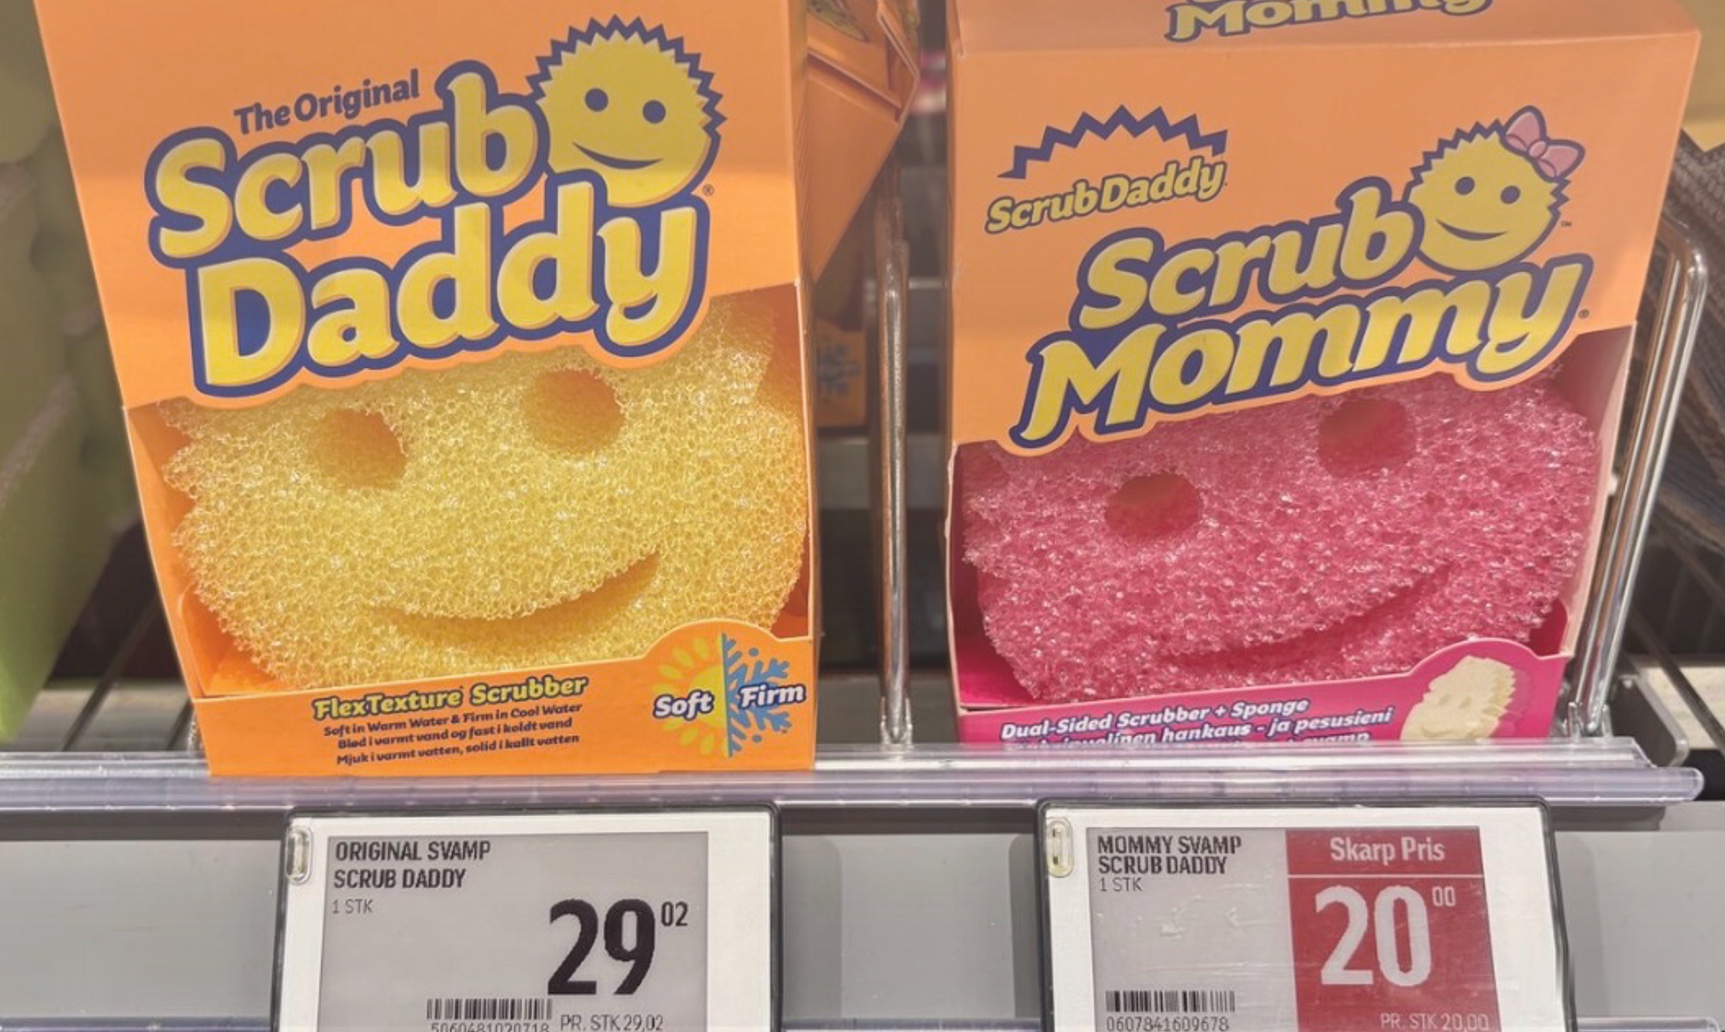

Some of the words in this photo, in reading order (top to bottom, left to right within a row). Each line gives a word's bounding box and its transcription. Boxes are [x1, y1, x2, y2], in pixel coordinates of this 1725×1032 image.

[234, 102, 291, 135] The
[295, 69, 420, 123] Original
[147, 61, 546, 266] Scrub
[985, 178, 1099, 234] Scrub
[1099, 155, 1227, 212] Daddy
[1070, 177, 1425, 333] Scrub
[187, 171, 708, 397] Daddy
[1010, 254, 1592, 447] Mommy
[312, 690, 463, 720] FlexTexture
[470, 675, 589, 706] Scrubber
[653, 689, 715, 721] Soft
[738, 682, 807, 709] Firm
[324, 724, 350, 738] Soft
[352, 725, 365, 734] in
[367, 721, 407, 732] Warm
[409, 717, 449, 728] Water
[451, 714, 461, 724] &
[463, 711, 493, 723] Firm
[496, 709, 508, 720] in
[510, 706, 540, 718] Cool
[542, 703, 583, 715] Water
[375, 733, 415, 745] varmt
[417, 729, 449, 741] vand
[451, 730, 467, 741] og
[469, 726, 495, 740] fast
[503, 721, 538, 734] koldt
[540, 717, 573, 730] vand
[1000, 712, 1113, 740] Dual-Sided
[1116, 705, 1211, 728] Scrubber
[1230, 699, 1310, 720] Sponge
[1161, 722, 1251, 742] hankaus
[1267, 717, 1292, 737] ja
[1294, 706, 1395, 733] pesusieni
[336, 753, 369, 767] Mjuk
[376, 749, 416, 761] varmt
[466, 740, 497, 753] solid
[505, 737, 535, 750] kallt
[537, 734, 580, 746] vatten
[335, 841, 422, 861] ORIGINAL
[427, 840, 491, 860] SVAMP
[1098, 835, 1172, 854] MOMMY
[1177, 835, 1242, 854] SVAMP
[1330, 837, 1395, 863] Skarp
[1401, 836, 1446, 861] Pris
[333, 869, 397, 889] SCRUB
[402, 868, 467, 888] DADDY
[1098, 856, 1162, 874] SCRUB
[1166, 856, 1227, 874] DADDY
[1100, 877, 1107, 892] 1
[1112, 877, 1142, 892] STK
[332, 899, 340, 914] 1
[345, 899, 373, 914] STK
[547, 898, 656, 996] 29
[660, 902, 688, 927] 02
[1315, 884, 1432, 987] 20
[1432, 886, 1457, 908] 00
[560, 1014, 586, 1032] PR.
[590, 1014, 622, 1032] STK
[623, 1014, 664, 1032] 29,02
[1106, 1015, 1230, 1032] 0607841609678
[1381, 1013, 1407, 1030] PR.
[1410, 1013, 1437, 1031] STK
[1441, 1014, 1490, 1032] 20,00
